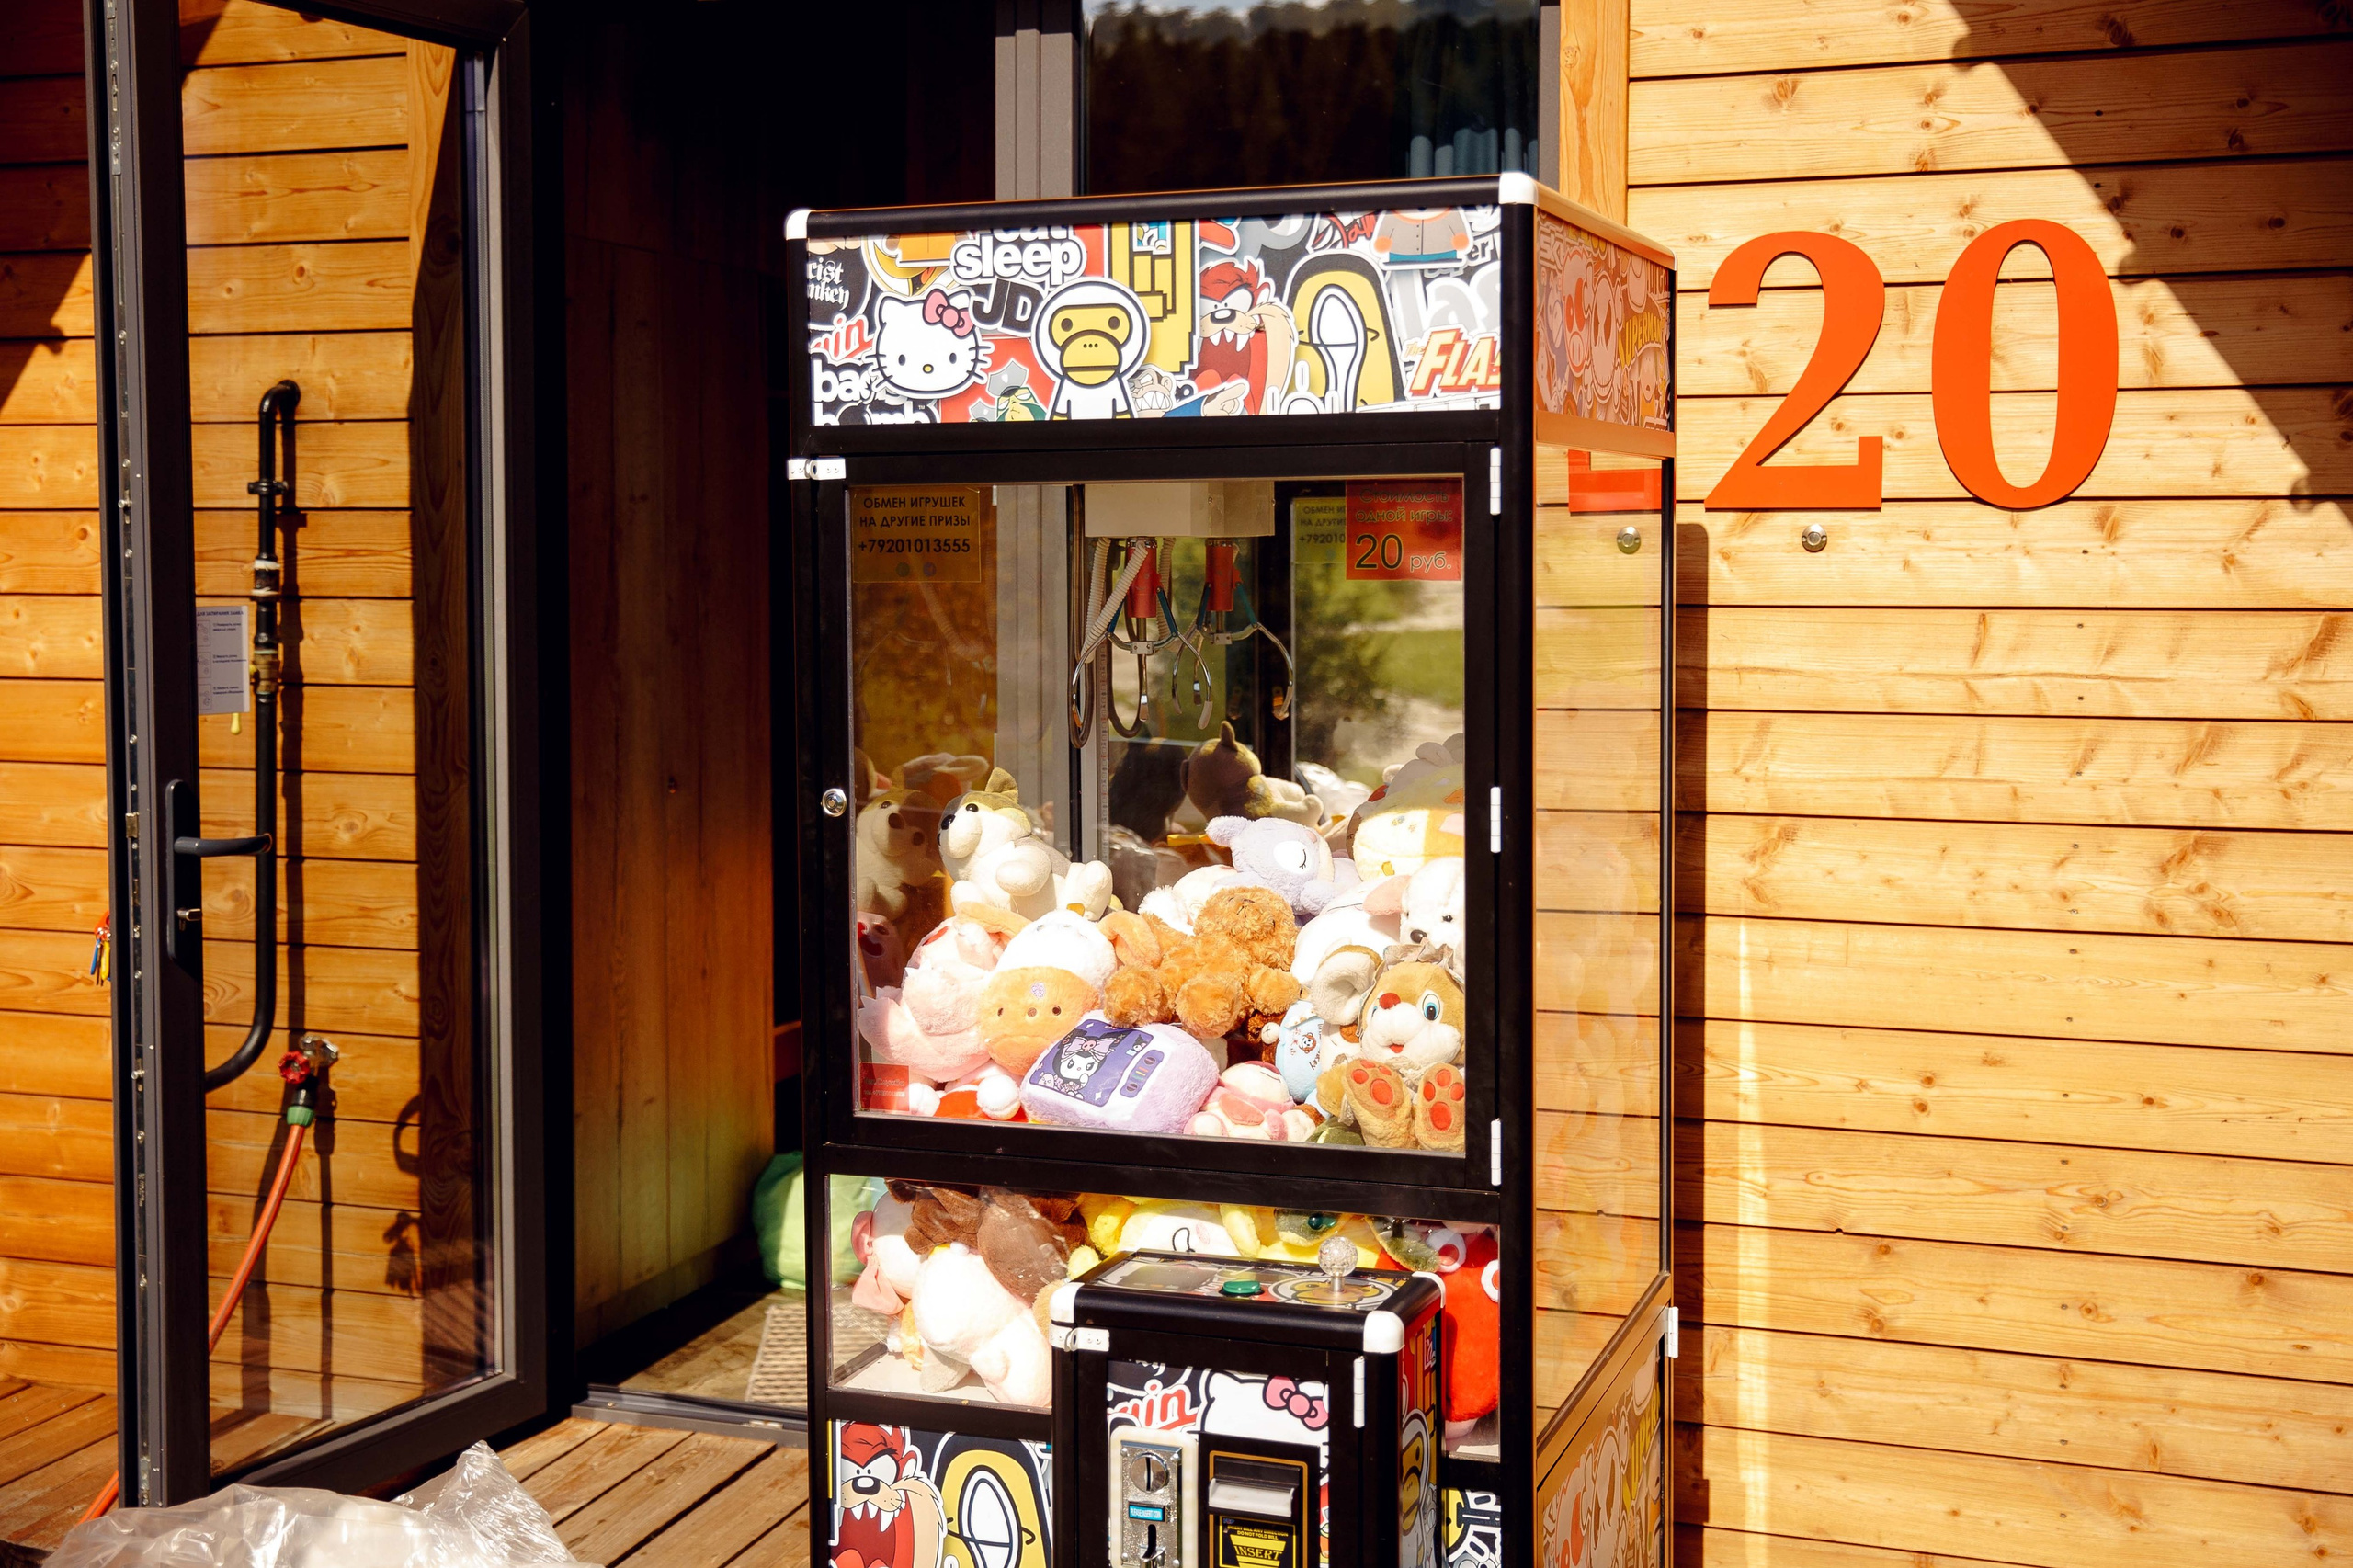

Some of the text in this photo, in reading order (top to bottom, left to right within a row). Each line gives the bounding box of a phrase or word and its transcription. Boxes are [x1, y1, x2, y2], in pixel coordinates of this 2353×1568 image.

[954, 234, 1082, 286] sleep
[1704, 219, 2120, 509] 20
[863, 496, 966, 508] ОБМЕН ИГРУШЕК
[1359, 488, 1449, 503] Стоимость
[859, 515, 970, 528] НА ДРУГИЕ ПРИЗЫ
[1356, 506, 1406, 522] одной
[858, 538, 971, 553] +79201013555
[1355, 533, 1451, 573] 20 руб.
[1233, 1545, 1283, 1561] INSERT
